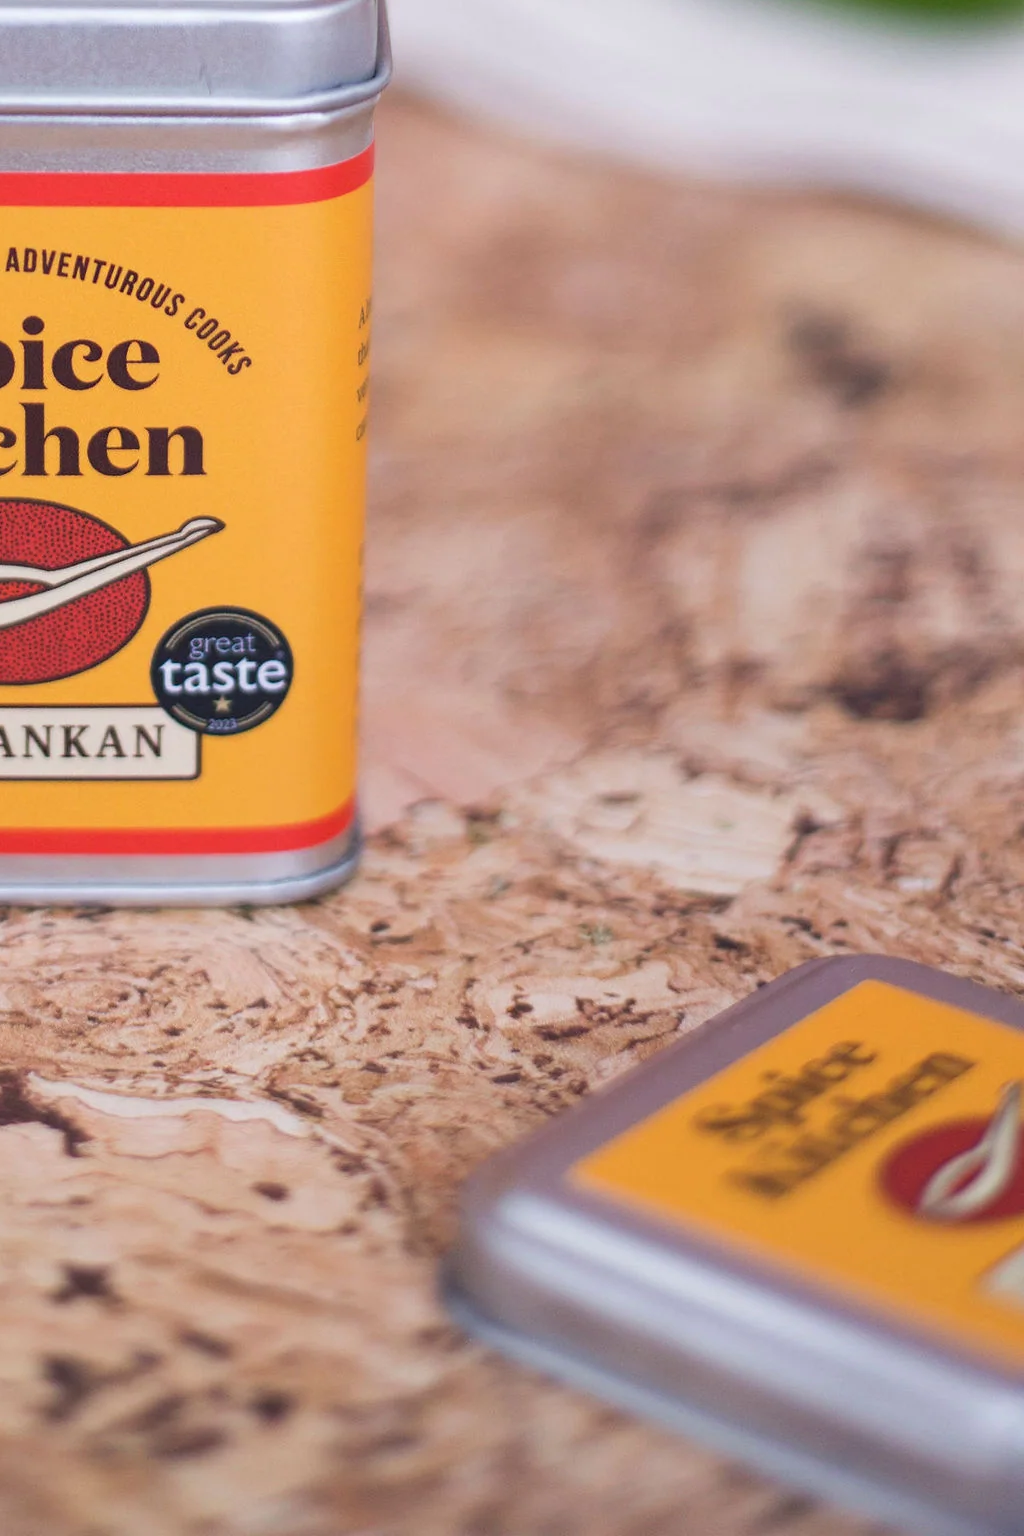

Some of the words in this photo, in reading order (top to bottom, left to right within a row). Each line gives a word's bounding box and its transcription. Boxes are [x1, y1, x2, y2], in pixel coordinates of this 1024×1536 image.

[5, 247, 185, 316] ADVENTUROUS
[184, 307, 252, 375] COOKS
[159, 657, 286, 693] taste
[189, 632, 256, 659] great
[692, 1039, 877, 1139] Spice
